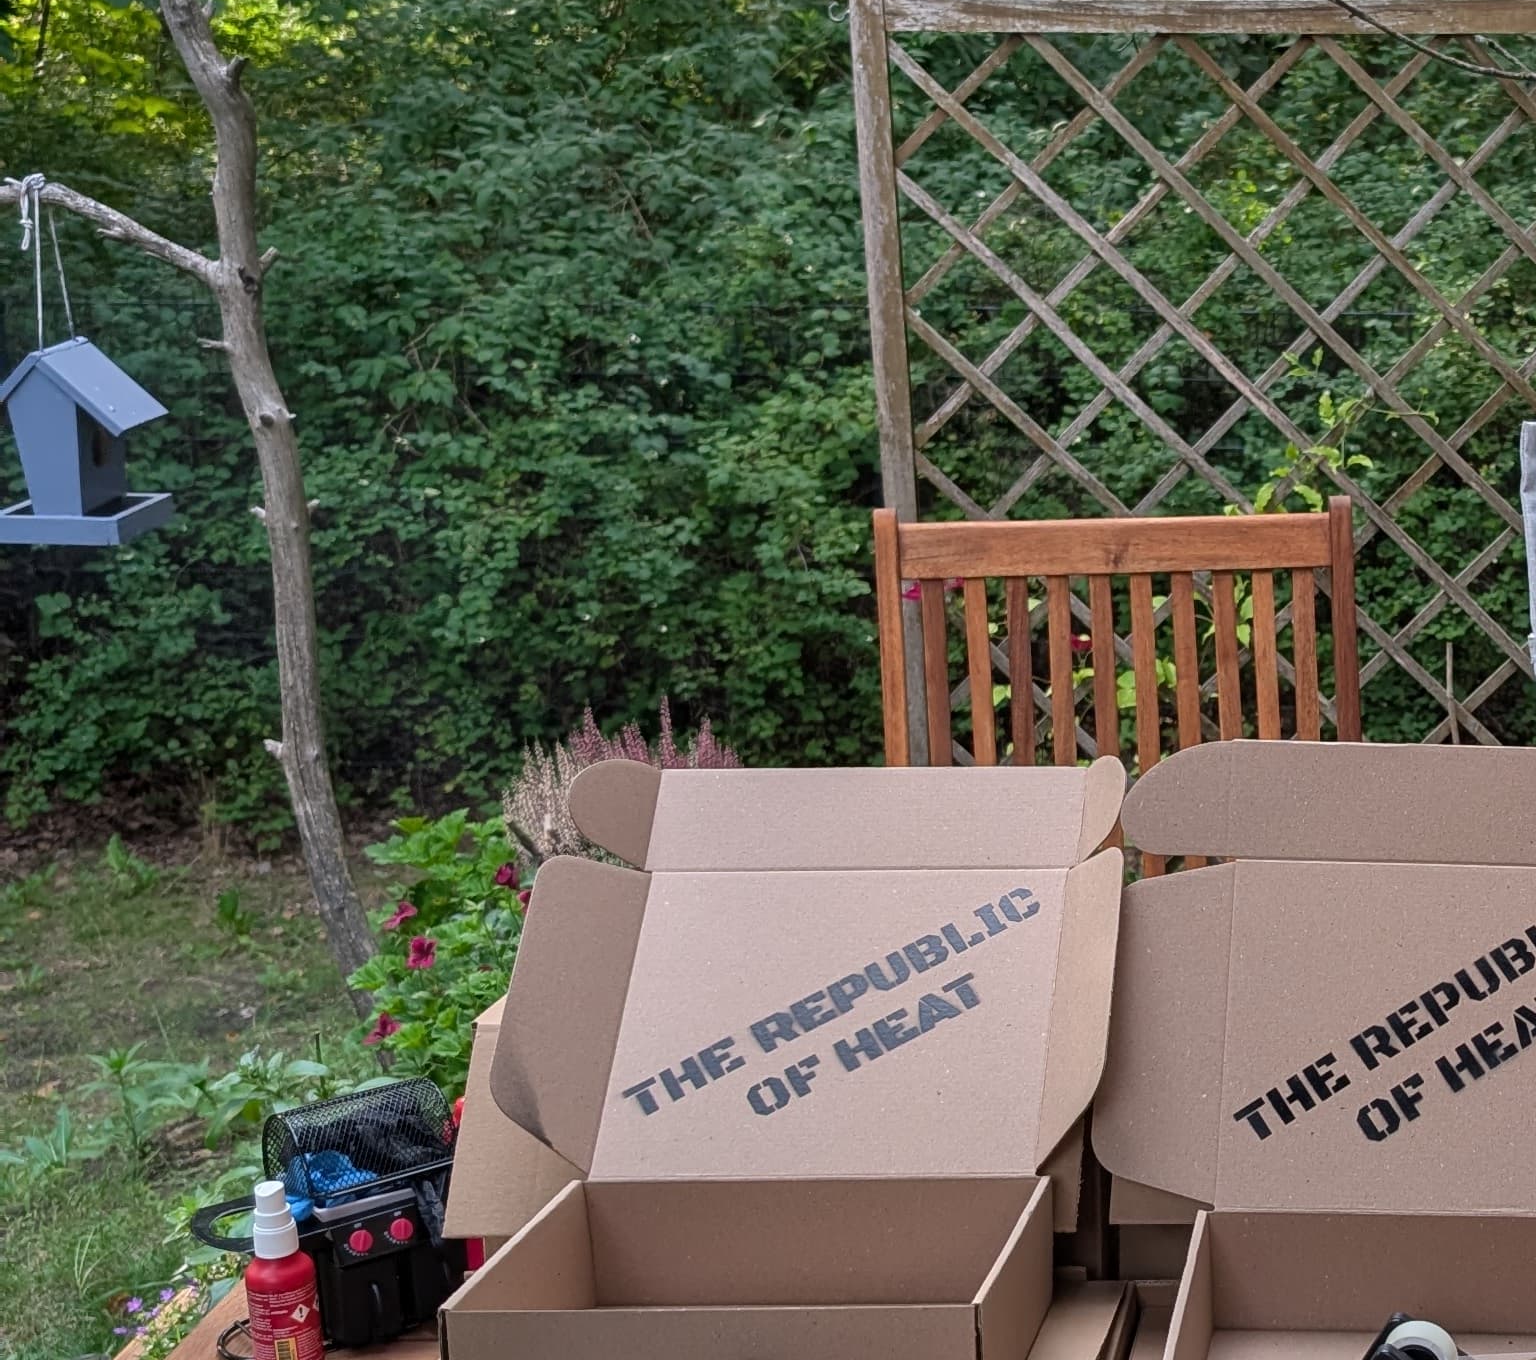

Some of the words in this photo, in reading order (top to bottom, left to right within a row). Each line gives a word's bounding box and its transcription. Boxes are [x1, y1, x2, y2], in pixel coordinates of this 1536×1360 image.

[622, 1036, 747, 1116] THE
[749, 887, 1041, 1053] REPUBLIC
[746, 1054, 821, 1116] OF
[832, 972, 981, 1072] HEAT
[1233, 1052, 1351, 1140] THE
[1356, 1073, 1425, 1142] OF
